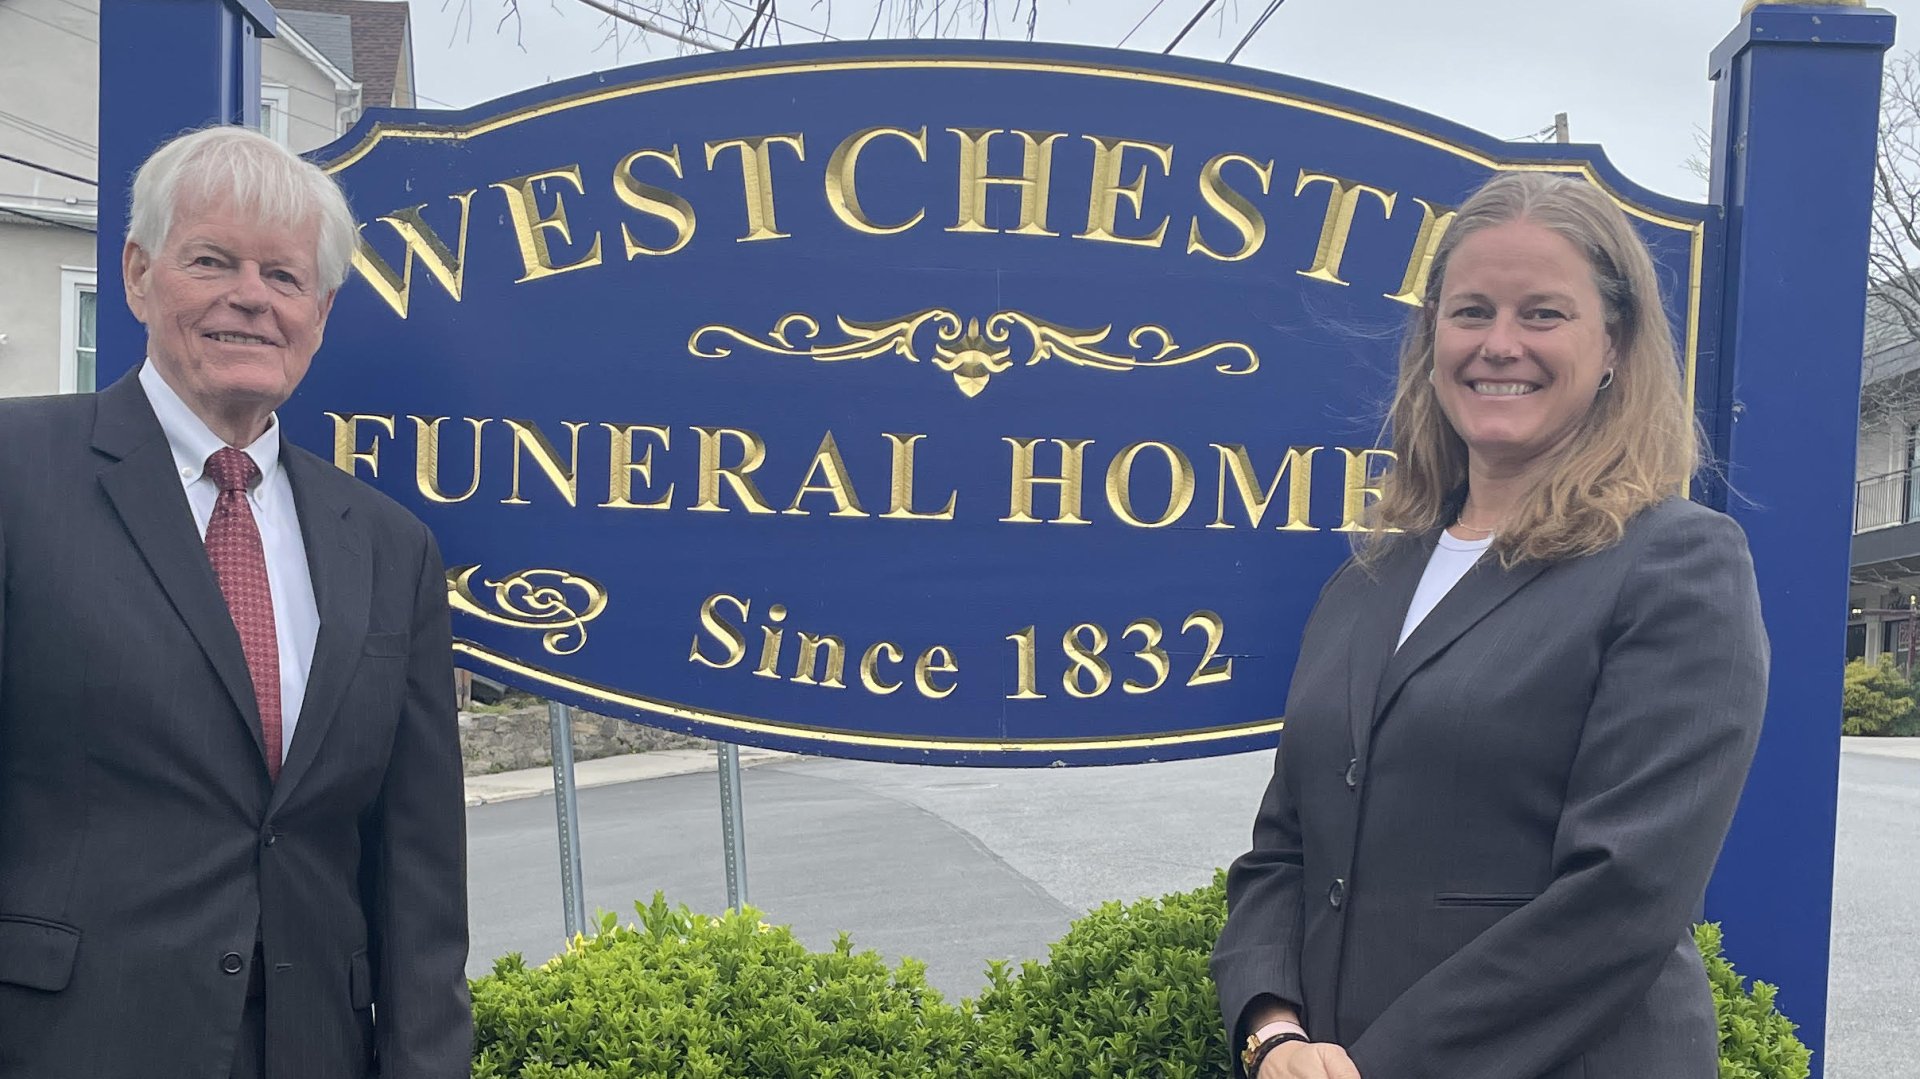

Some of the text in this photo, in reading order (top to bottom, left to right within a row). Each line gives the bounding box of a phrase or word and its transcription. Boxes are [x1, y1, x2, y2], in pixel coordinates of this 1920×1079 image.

[323, 411, 1404, 533] FUNERAL HOME
[688, 593, 1233, 700] Since 1832
